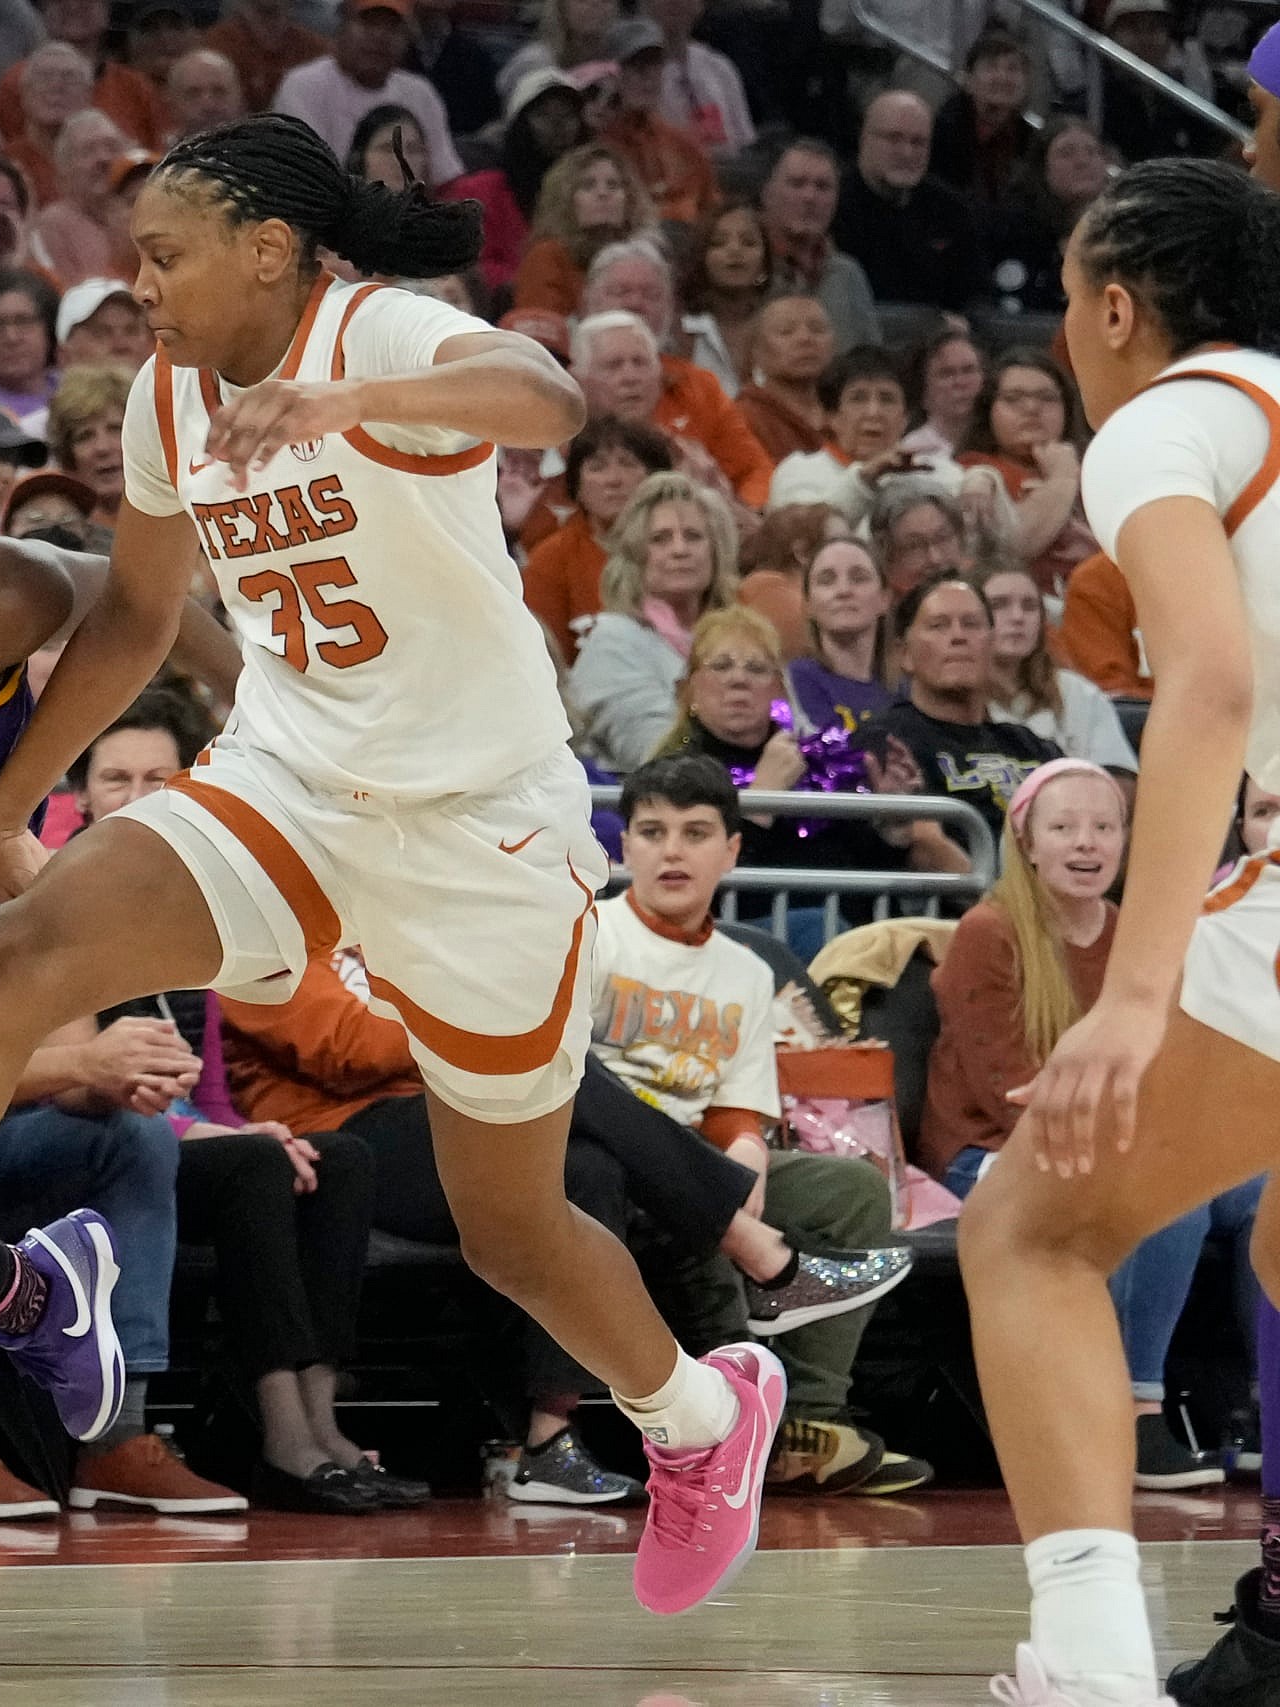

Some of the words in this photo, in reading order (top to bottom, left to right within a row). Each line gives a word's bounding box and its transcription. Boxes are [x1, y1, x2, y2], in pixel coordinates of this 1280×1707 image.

[191, 474, 358, 560] TEXAS
[238, 556, 389, 674] 35
[605, 973, 744, 1061] TEXAS
